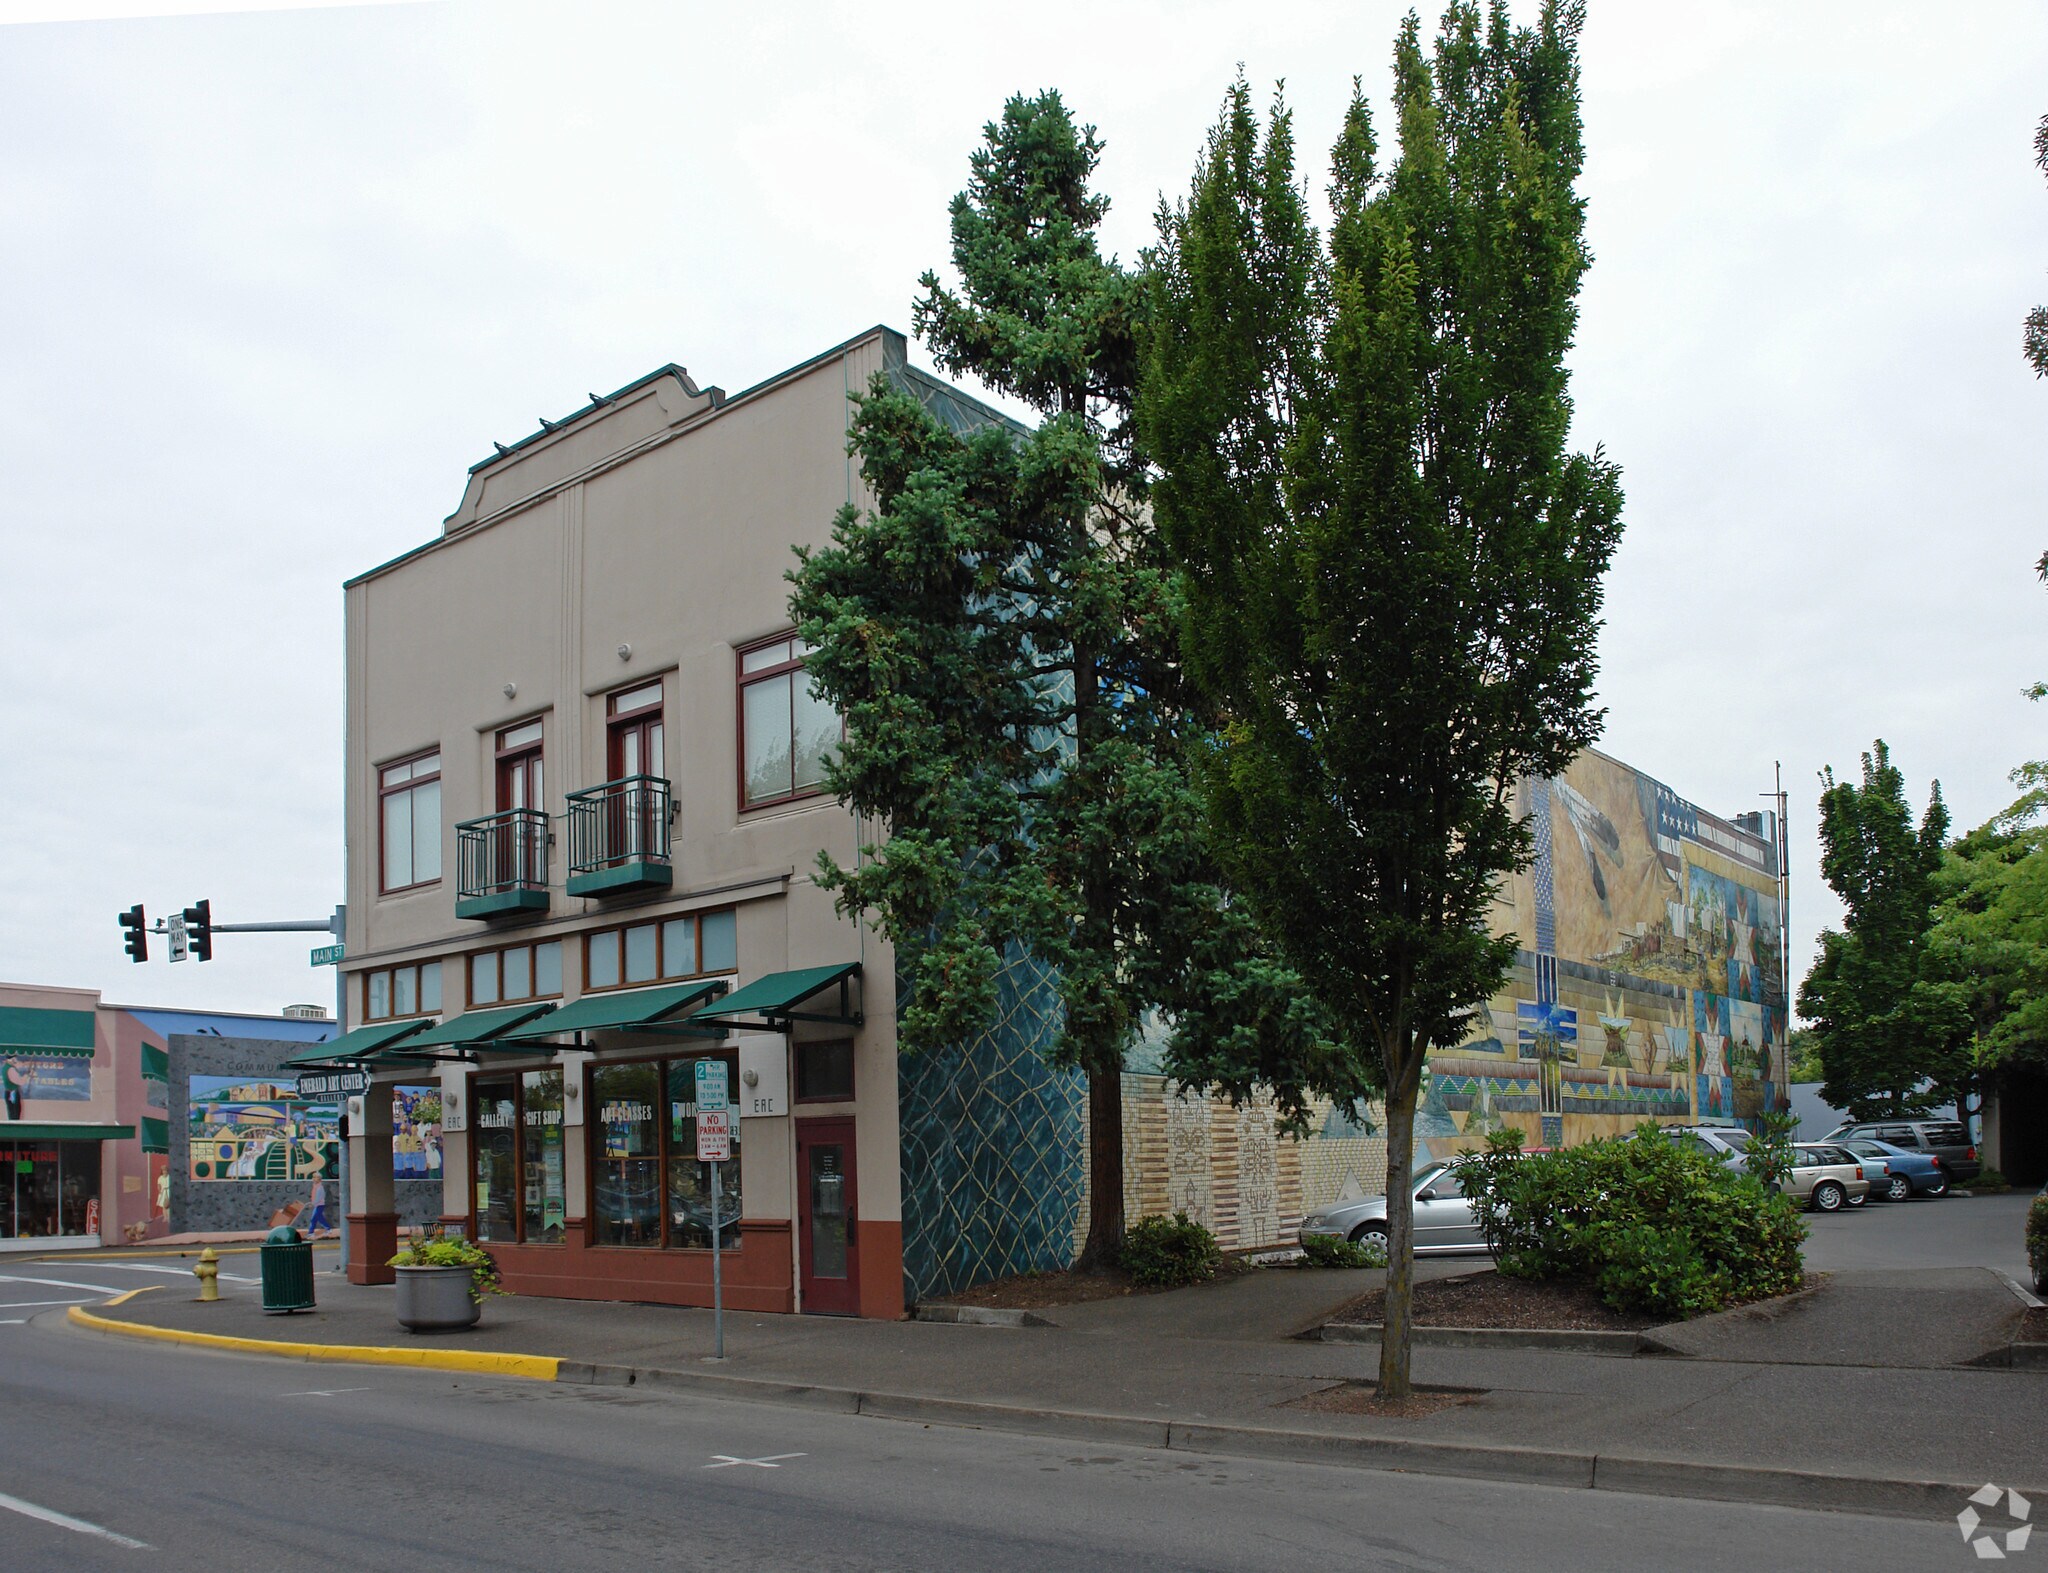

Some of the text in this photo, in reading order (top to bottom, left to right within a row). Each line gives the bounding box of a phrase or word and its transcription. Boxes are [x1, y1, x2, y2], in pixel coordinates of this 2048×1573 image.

[170, 918, 183, 931] ONE
[170, 930, 185, 943] WAY
[313, 945, 343, 964] MAIN ST
[697, 1065, 705, 1078] 2
[300, 1073, 364, 1094] EMERALD ART CENTER
[754, 1098, 774, 1113] EAC
[480, 1110, 562, 1128] GALLERY GIFT SHOP
[600, 1104, 652, 1123] ART CLASSES
[706, 1115, 719, 1125] NO
[447, 1116, 462, 1128] EAC
[699, 1125, 727, 1136] PARKING
[236, 1183, 301, 1195] RESPECT
[407, 1183, 443, 1194] DIGN
[89, 1201, 98, 1235] SALE
